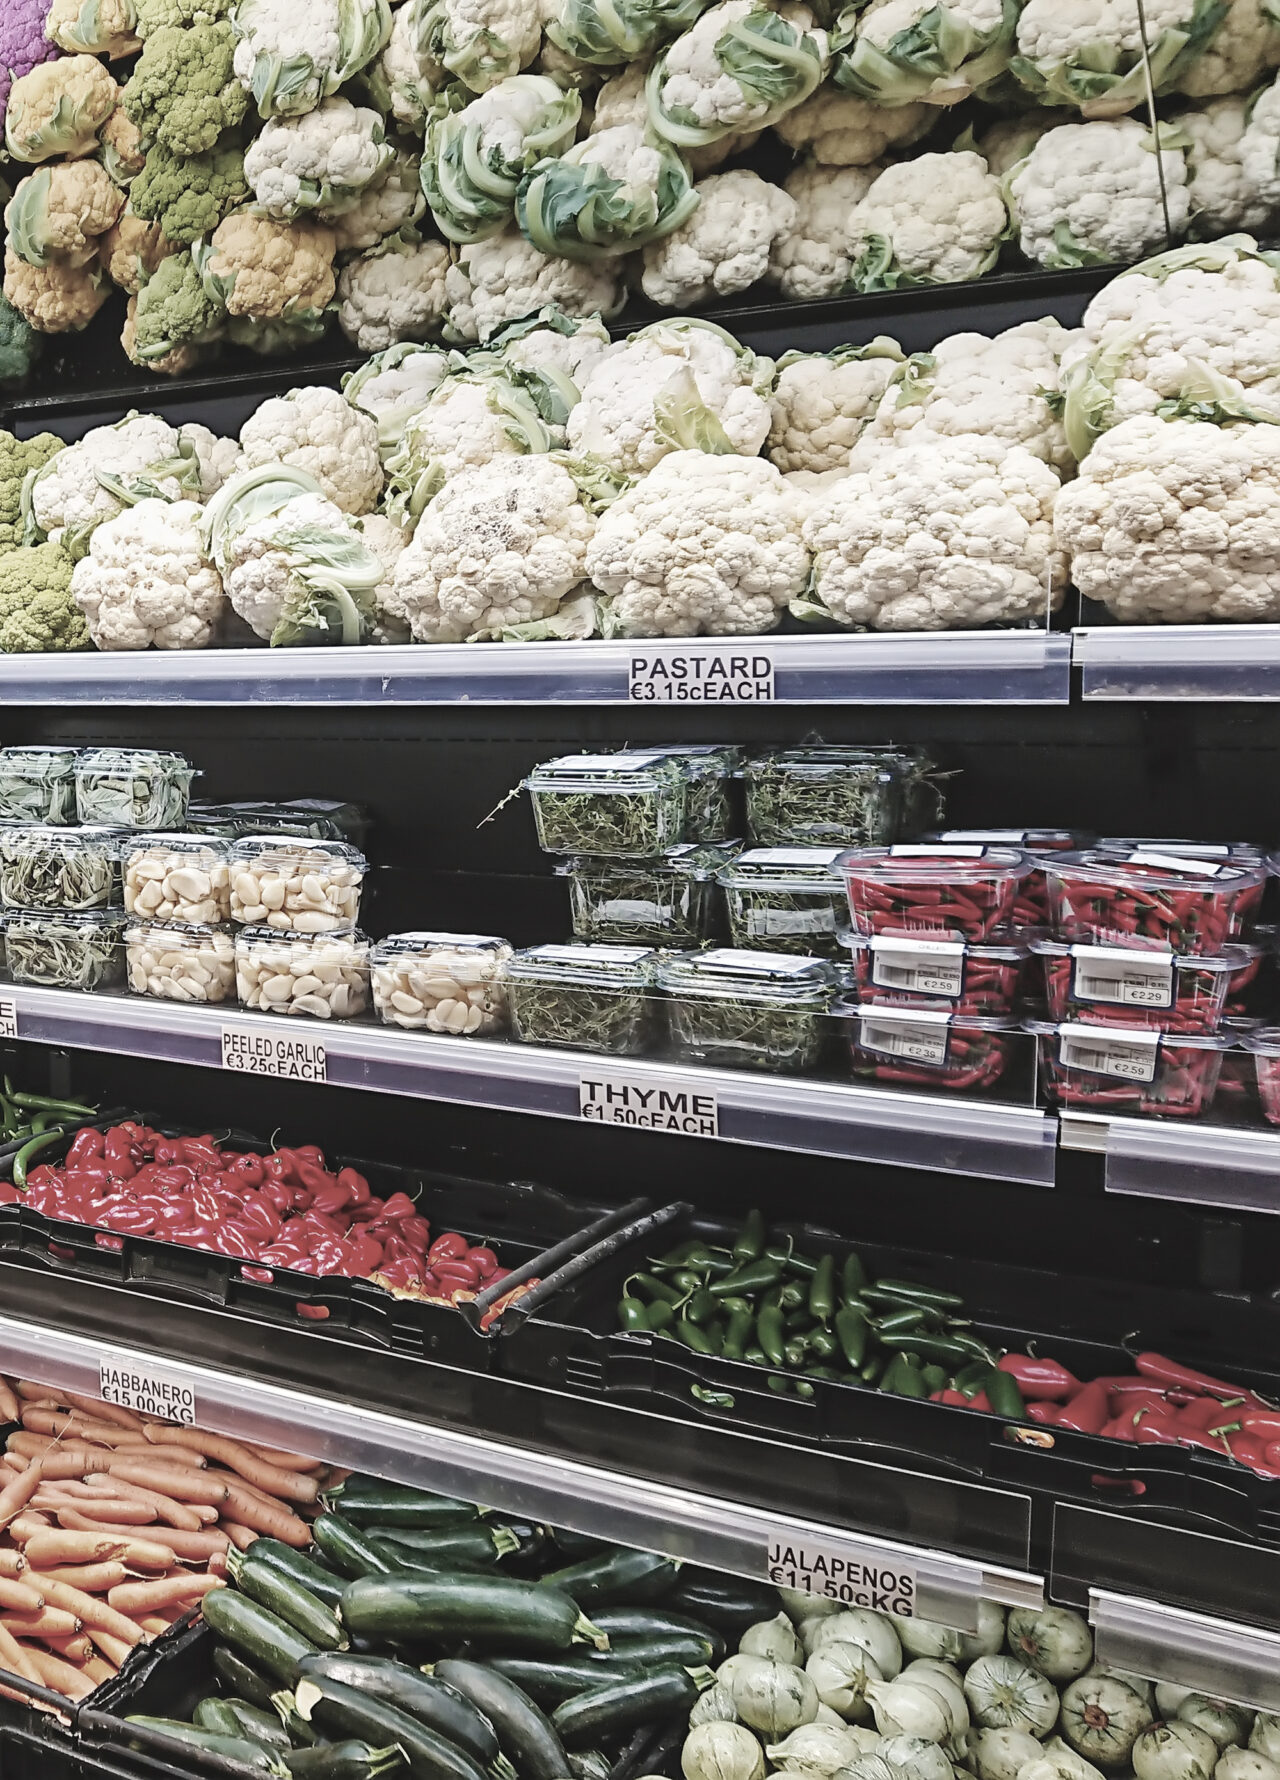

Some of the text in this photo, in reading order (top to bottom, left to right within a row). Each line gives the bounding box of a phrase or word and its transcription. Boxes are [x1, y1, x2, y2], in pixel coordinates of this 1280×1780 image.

[631, 656, 771, 679] PASTARD
[630, 681, 771, 700] €3.15cEACH
[223, 1033, 325, 1064] PEELED GARLIC
[226, 1053, 325, 1080] €3.25cEACH
[581, 1080, 715, 1117] THYME
[101, 1366, 193, 1406] HABBANERO
[102, 1386, 194, 1423] €15.00cKG
[769, 1544, 913, 1597] JALAPENOS
[769, 1566, 913, 1617] €11.50cKG
